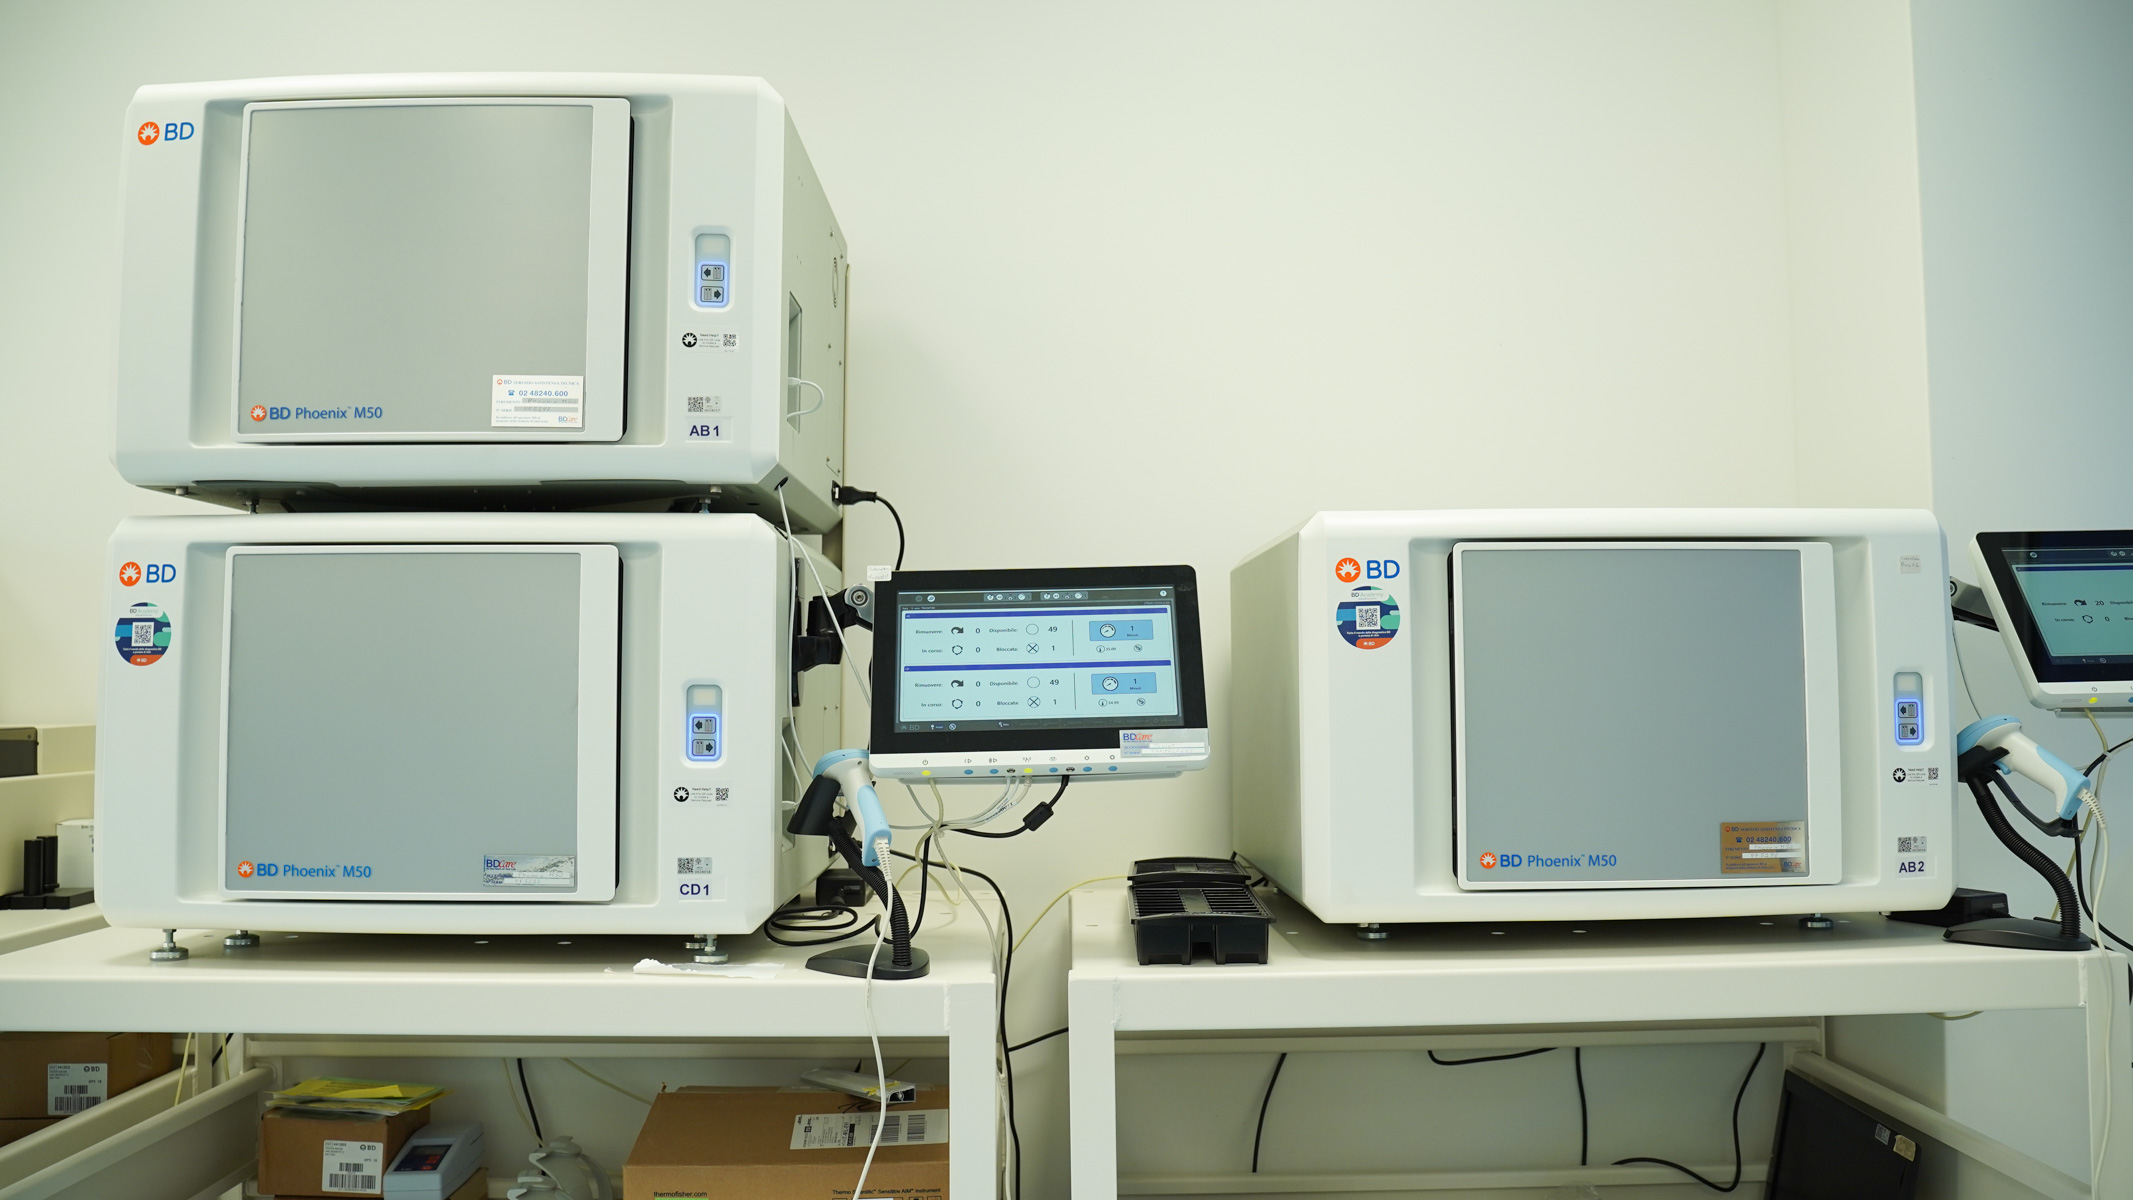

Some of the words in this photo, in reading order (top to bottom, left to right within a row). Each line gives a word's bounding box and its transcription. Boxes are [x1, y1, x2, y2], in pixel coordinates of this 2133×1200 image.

[164, 122, 195, 142] BD
[269, 406, 291, 420] BD
[354, 406, 383, 419] M50
[146, 564, 176, 583] BD
[1366, 560, 1400, 579] BD
[486, 859, 516, 868] BDCare
[1500, 854, 1522, 867] BD
[1588, 854, 1617, 867] M50
[257, 863, 278, 876] BD
[342, 866, 372, 878] M50
